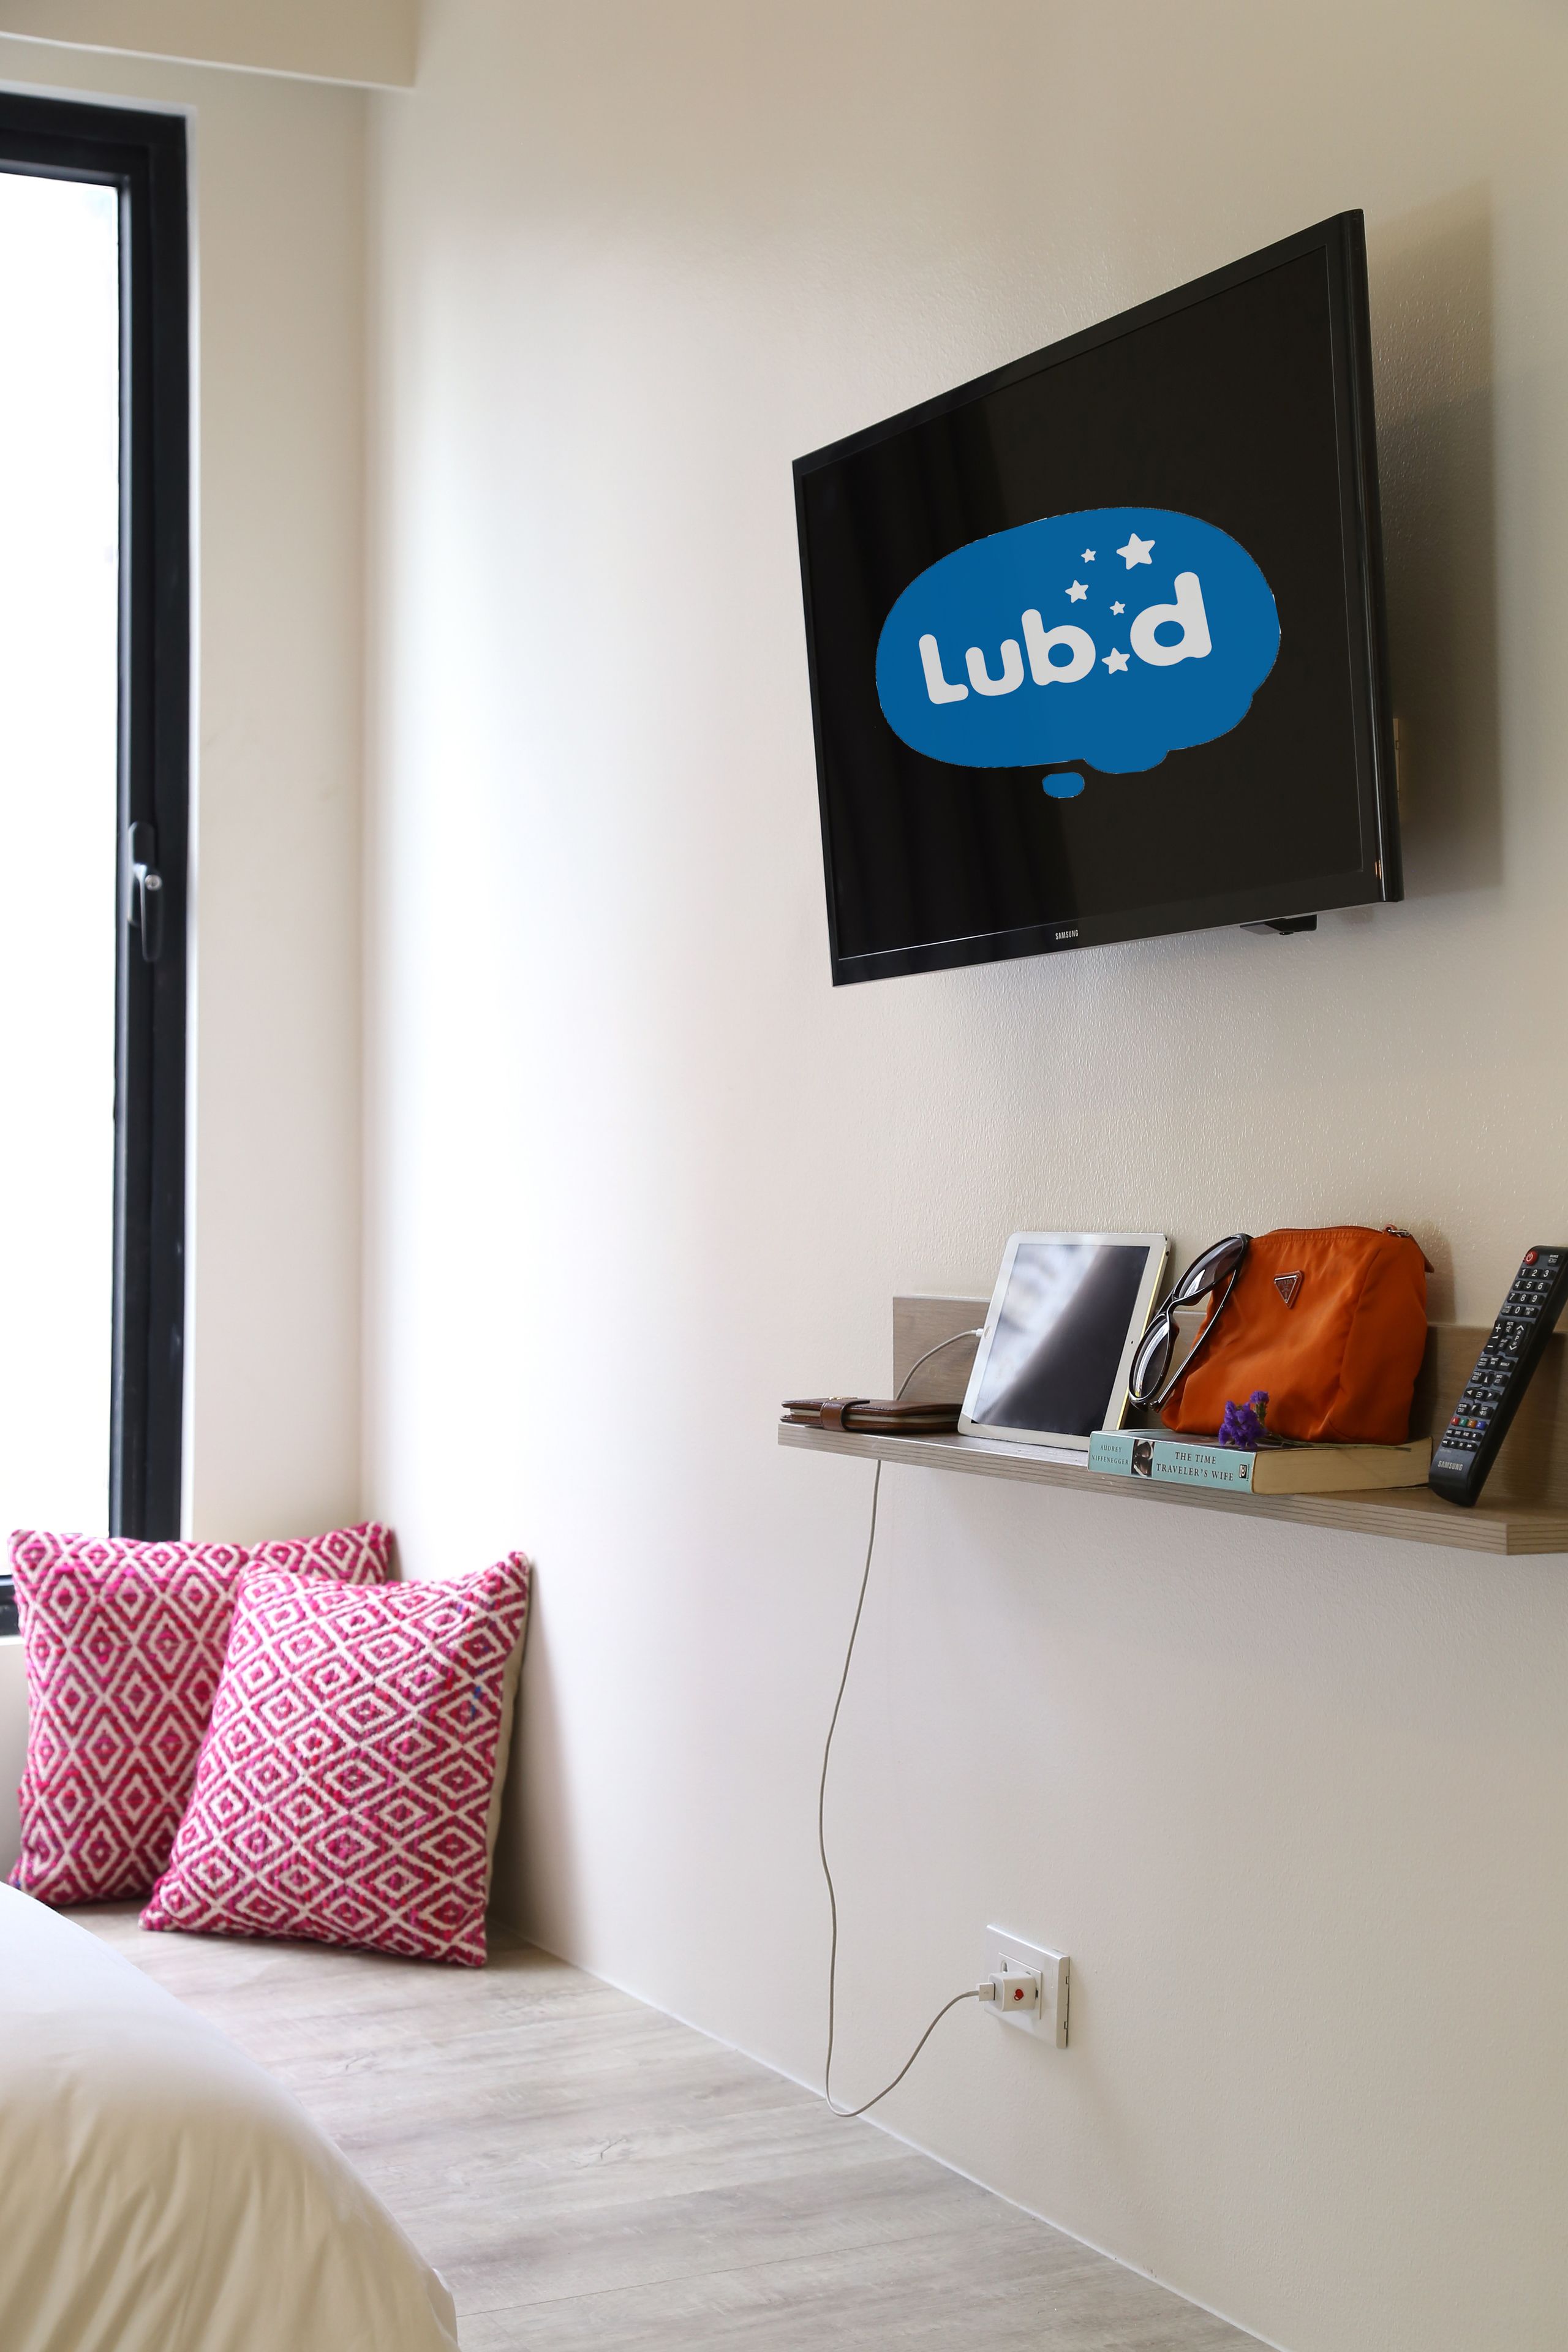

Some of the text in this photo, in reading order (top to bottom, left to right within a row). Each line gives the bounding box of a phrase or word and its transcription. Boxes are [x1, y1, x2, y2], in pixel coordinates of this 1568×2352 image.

[1055, 929, 1079, 940] SAMSUNG
[1091, 1455, 1129, 1465] NIFFENEGGER
[1175, 1451, 1216, 1464] THE TIME
[1438, 1460, 1463, 1471] SAMSUNG
[1156, 1463, 1208, 1477] TRAVELER'S
[1212, 1470, 1234, 1481] WIFE
